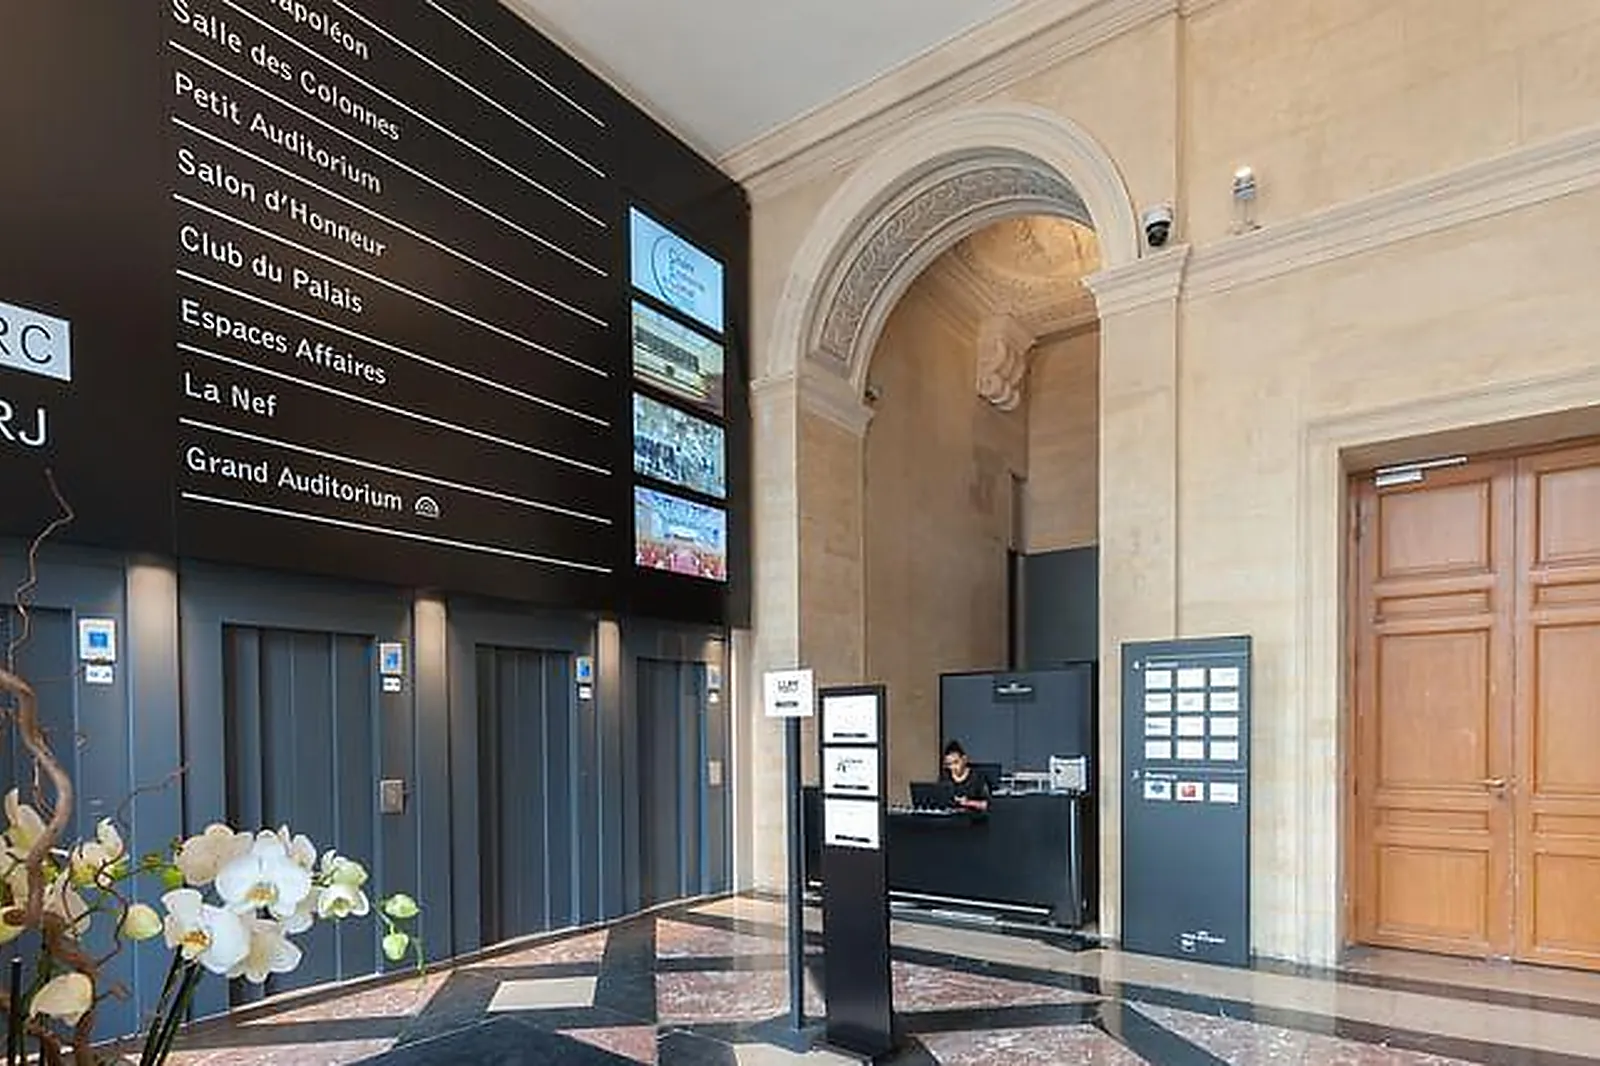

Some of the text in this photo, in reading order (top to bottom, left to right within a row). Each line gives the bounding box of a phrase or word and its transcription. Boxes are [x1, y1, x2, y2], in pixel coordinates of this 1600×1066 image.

[172, 0, 399, 141] Salle des Colonnes
[270, 0, 369, 60] apoléon
[175, 71, 381, 193] Petit Auditorium
[177, 148, 387, 257] Salon d'Honneur
[180, 225, 363, 314] Club du Palais
[182, 298, 387, 385] Espaces Affaires
[185, 371, 277, 417] La Nef
[186, 446, 402, 511] Grand Auditorium
